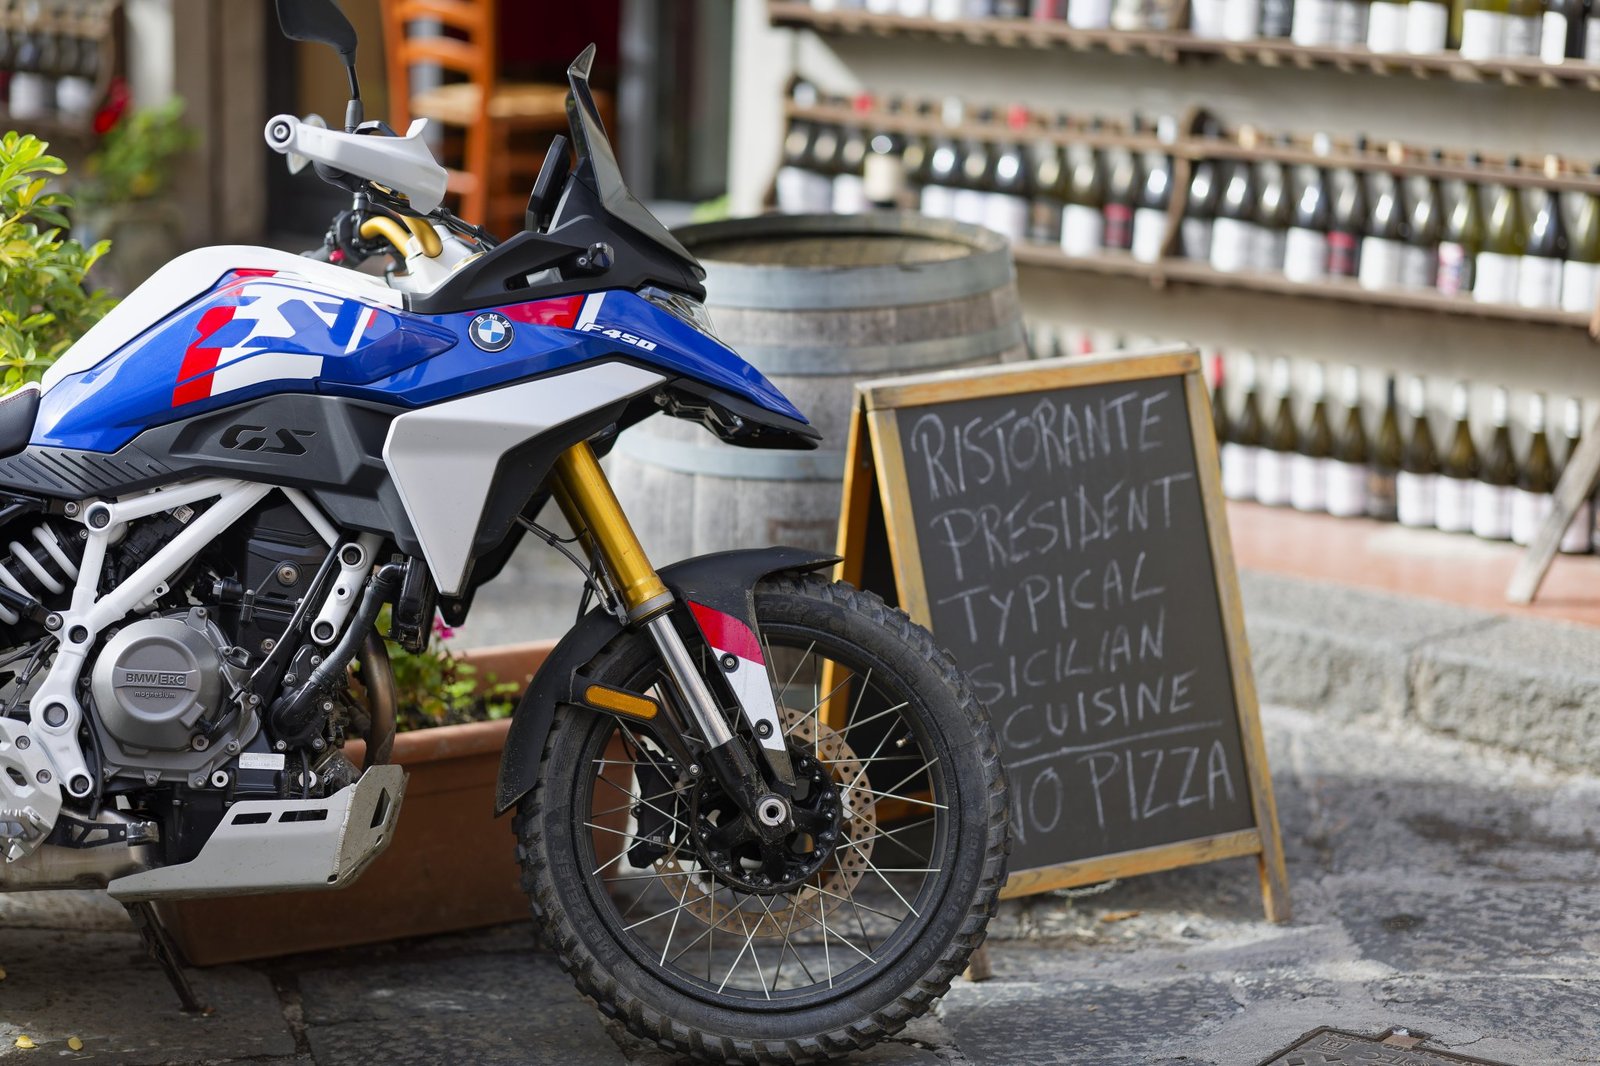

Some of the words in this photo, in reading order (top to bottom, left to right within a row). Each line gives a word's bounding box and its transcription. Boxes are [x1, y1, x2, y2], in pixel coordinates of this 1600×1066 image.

[475, 313, 512, 328] BMW
[219, 424, 318, 456] GS
[911, 391, 1170, 501] RISTORANTE
[929, 472, 1193, 581] PRESIDENT
[937, 551, 1166, 645] TYPICAL
[126, 673, 159, 685] BMW
[160, 674, 185, 686] ERC
[134, 690, 177, 700] magnesium
[968, 605, 1165, 706] SICILIAN
[1003, 668, 1198, 749] CUISINE
[1076, 739, 1236, 831] PIZZA
